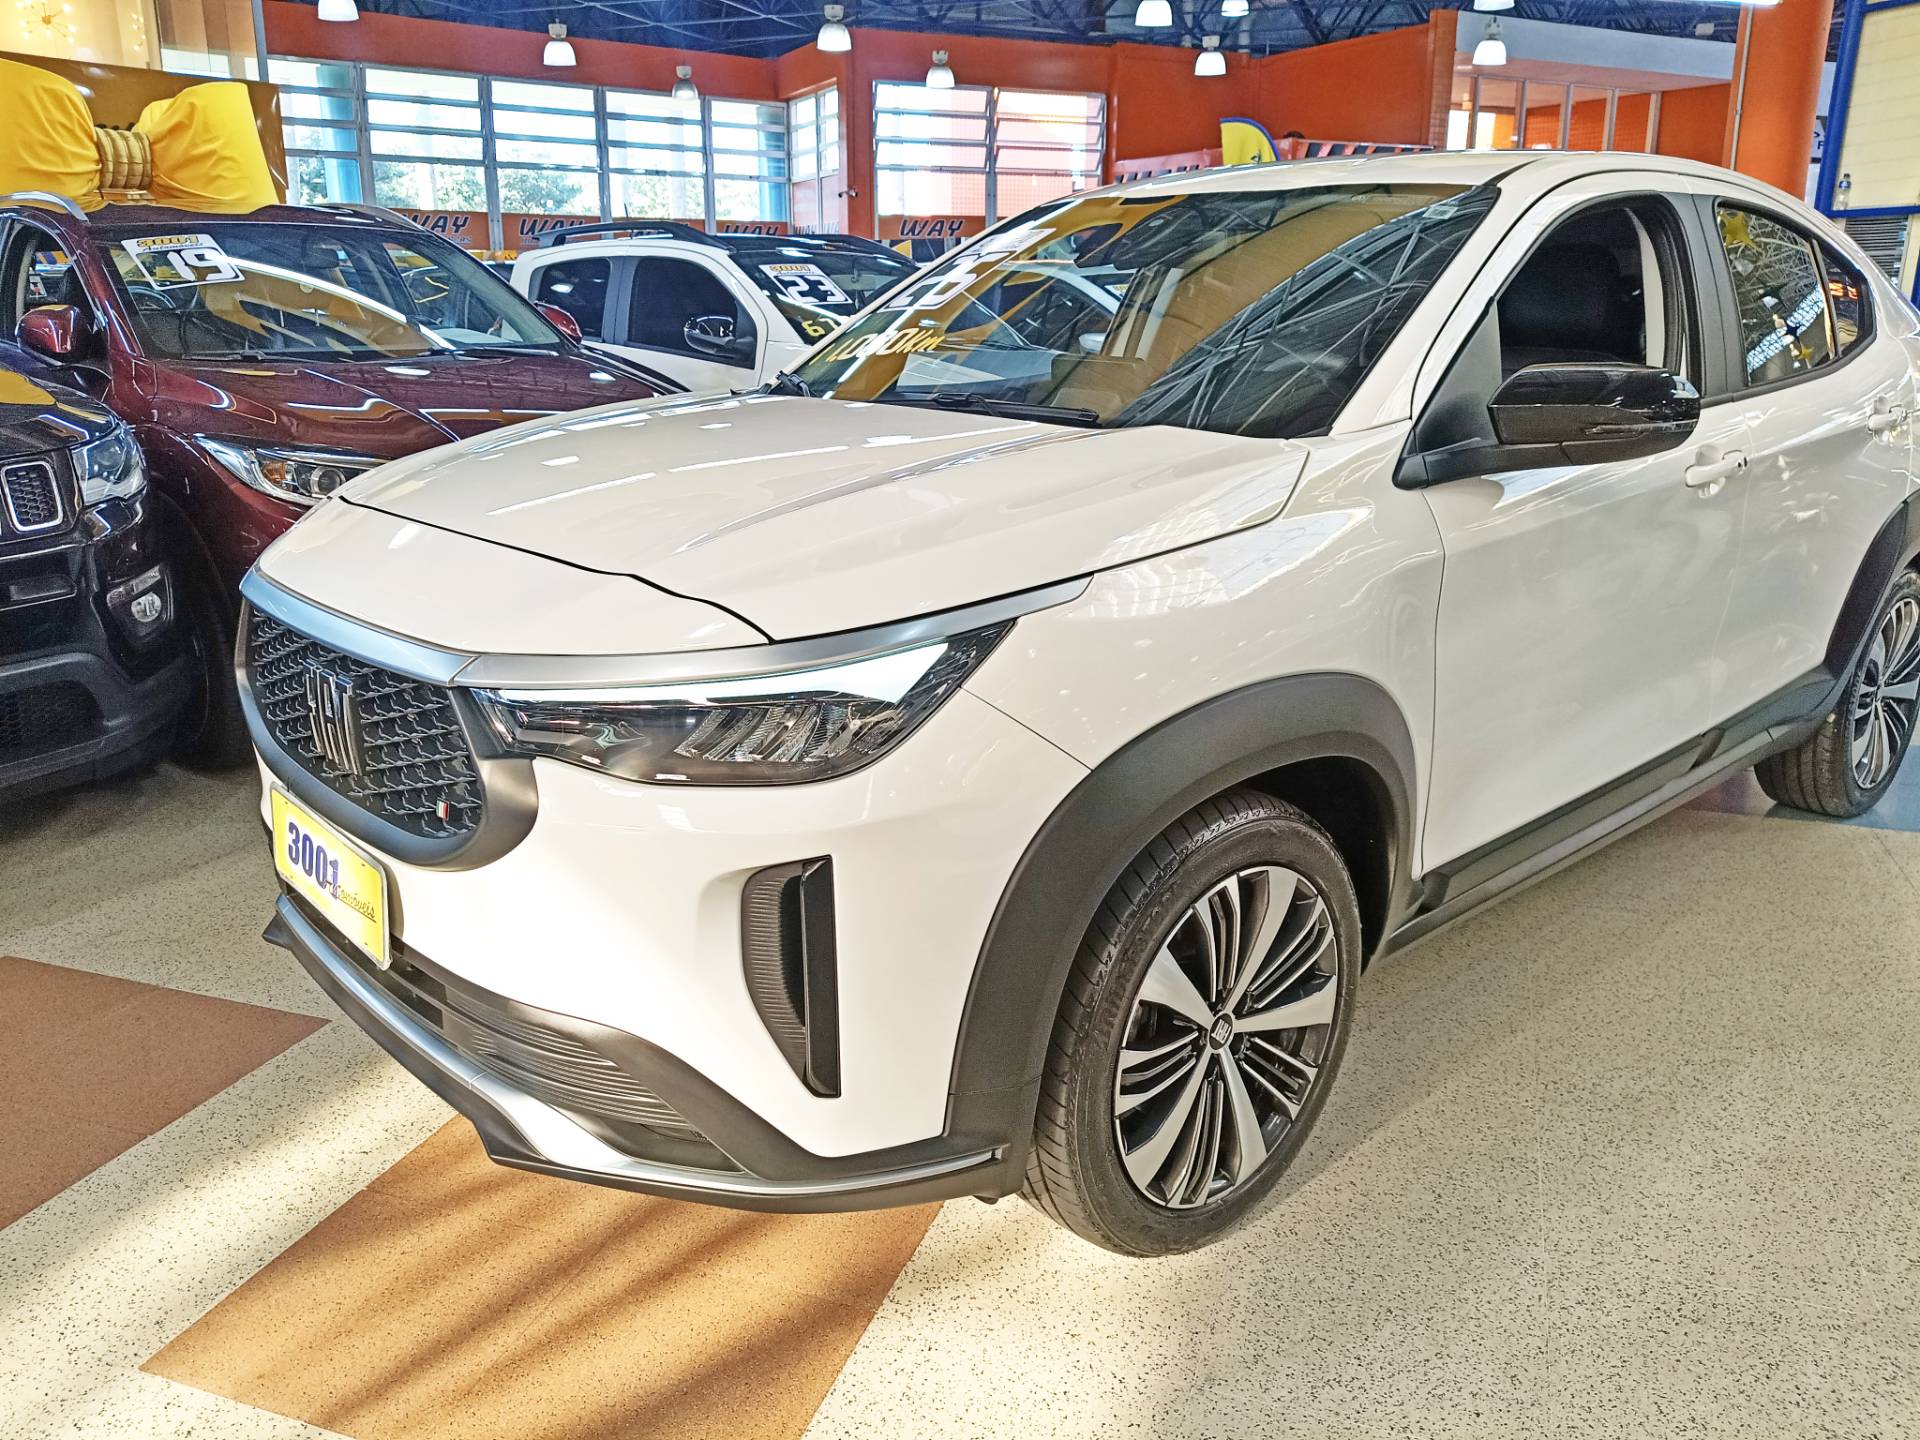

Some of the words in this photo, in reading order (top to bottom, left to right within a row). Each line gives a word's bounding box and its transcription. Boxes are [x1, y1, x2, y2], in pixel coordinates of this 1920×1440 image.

[899, 218, 965, 238] WAY
[167, 247, 237, 281] 19
[779, 275, 847, 302] 23
[303, 659, 360, 776] FIAT
[288, 821, 340, 900] 3001
